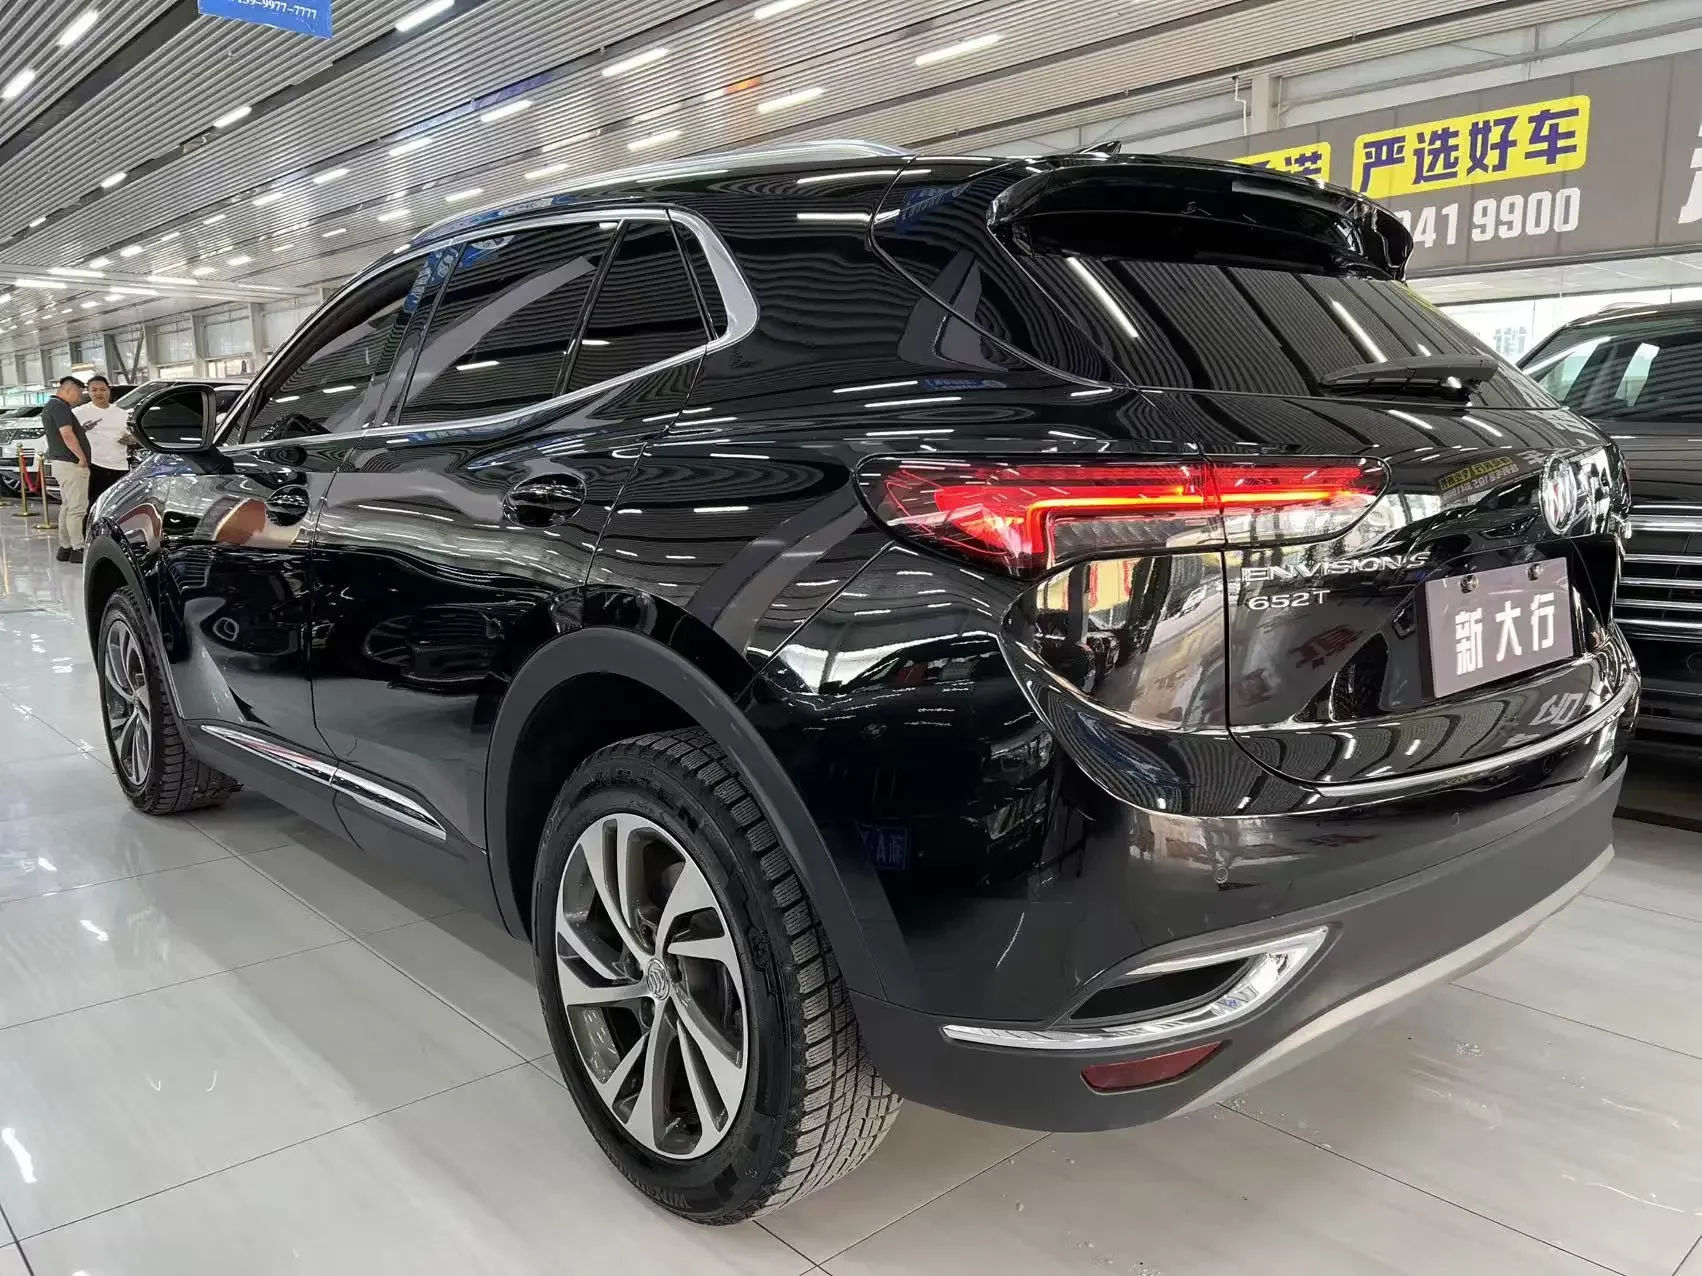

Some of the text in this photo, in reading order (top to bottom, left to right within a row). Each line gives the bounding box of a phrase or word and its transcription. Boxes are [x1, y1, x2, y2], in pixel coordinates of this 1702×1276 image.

[1359, 107, 1580, 193] 严选好车
[1471, 187, 1581, 242] 9900
[1248, 589, 1331, 611] 652T
[1455, 592, 1555, 675] 新大行
